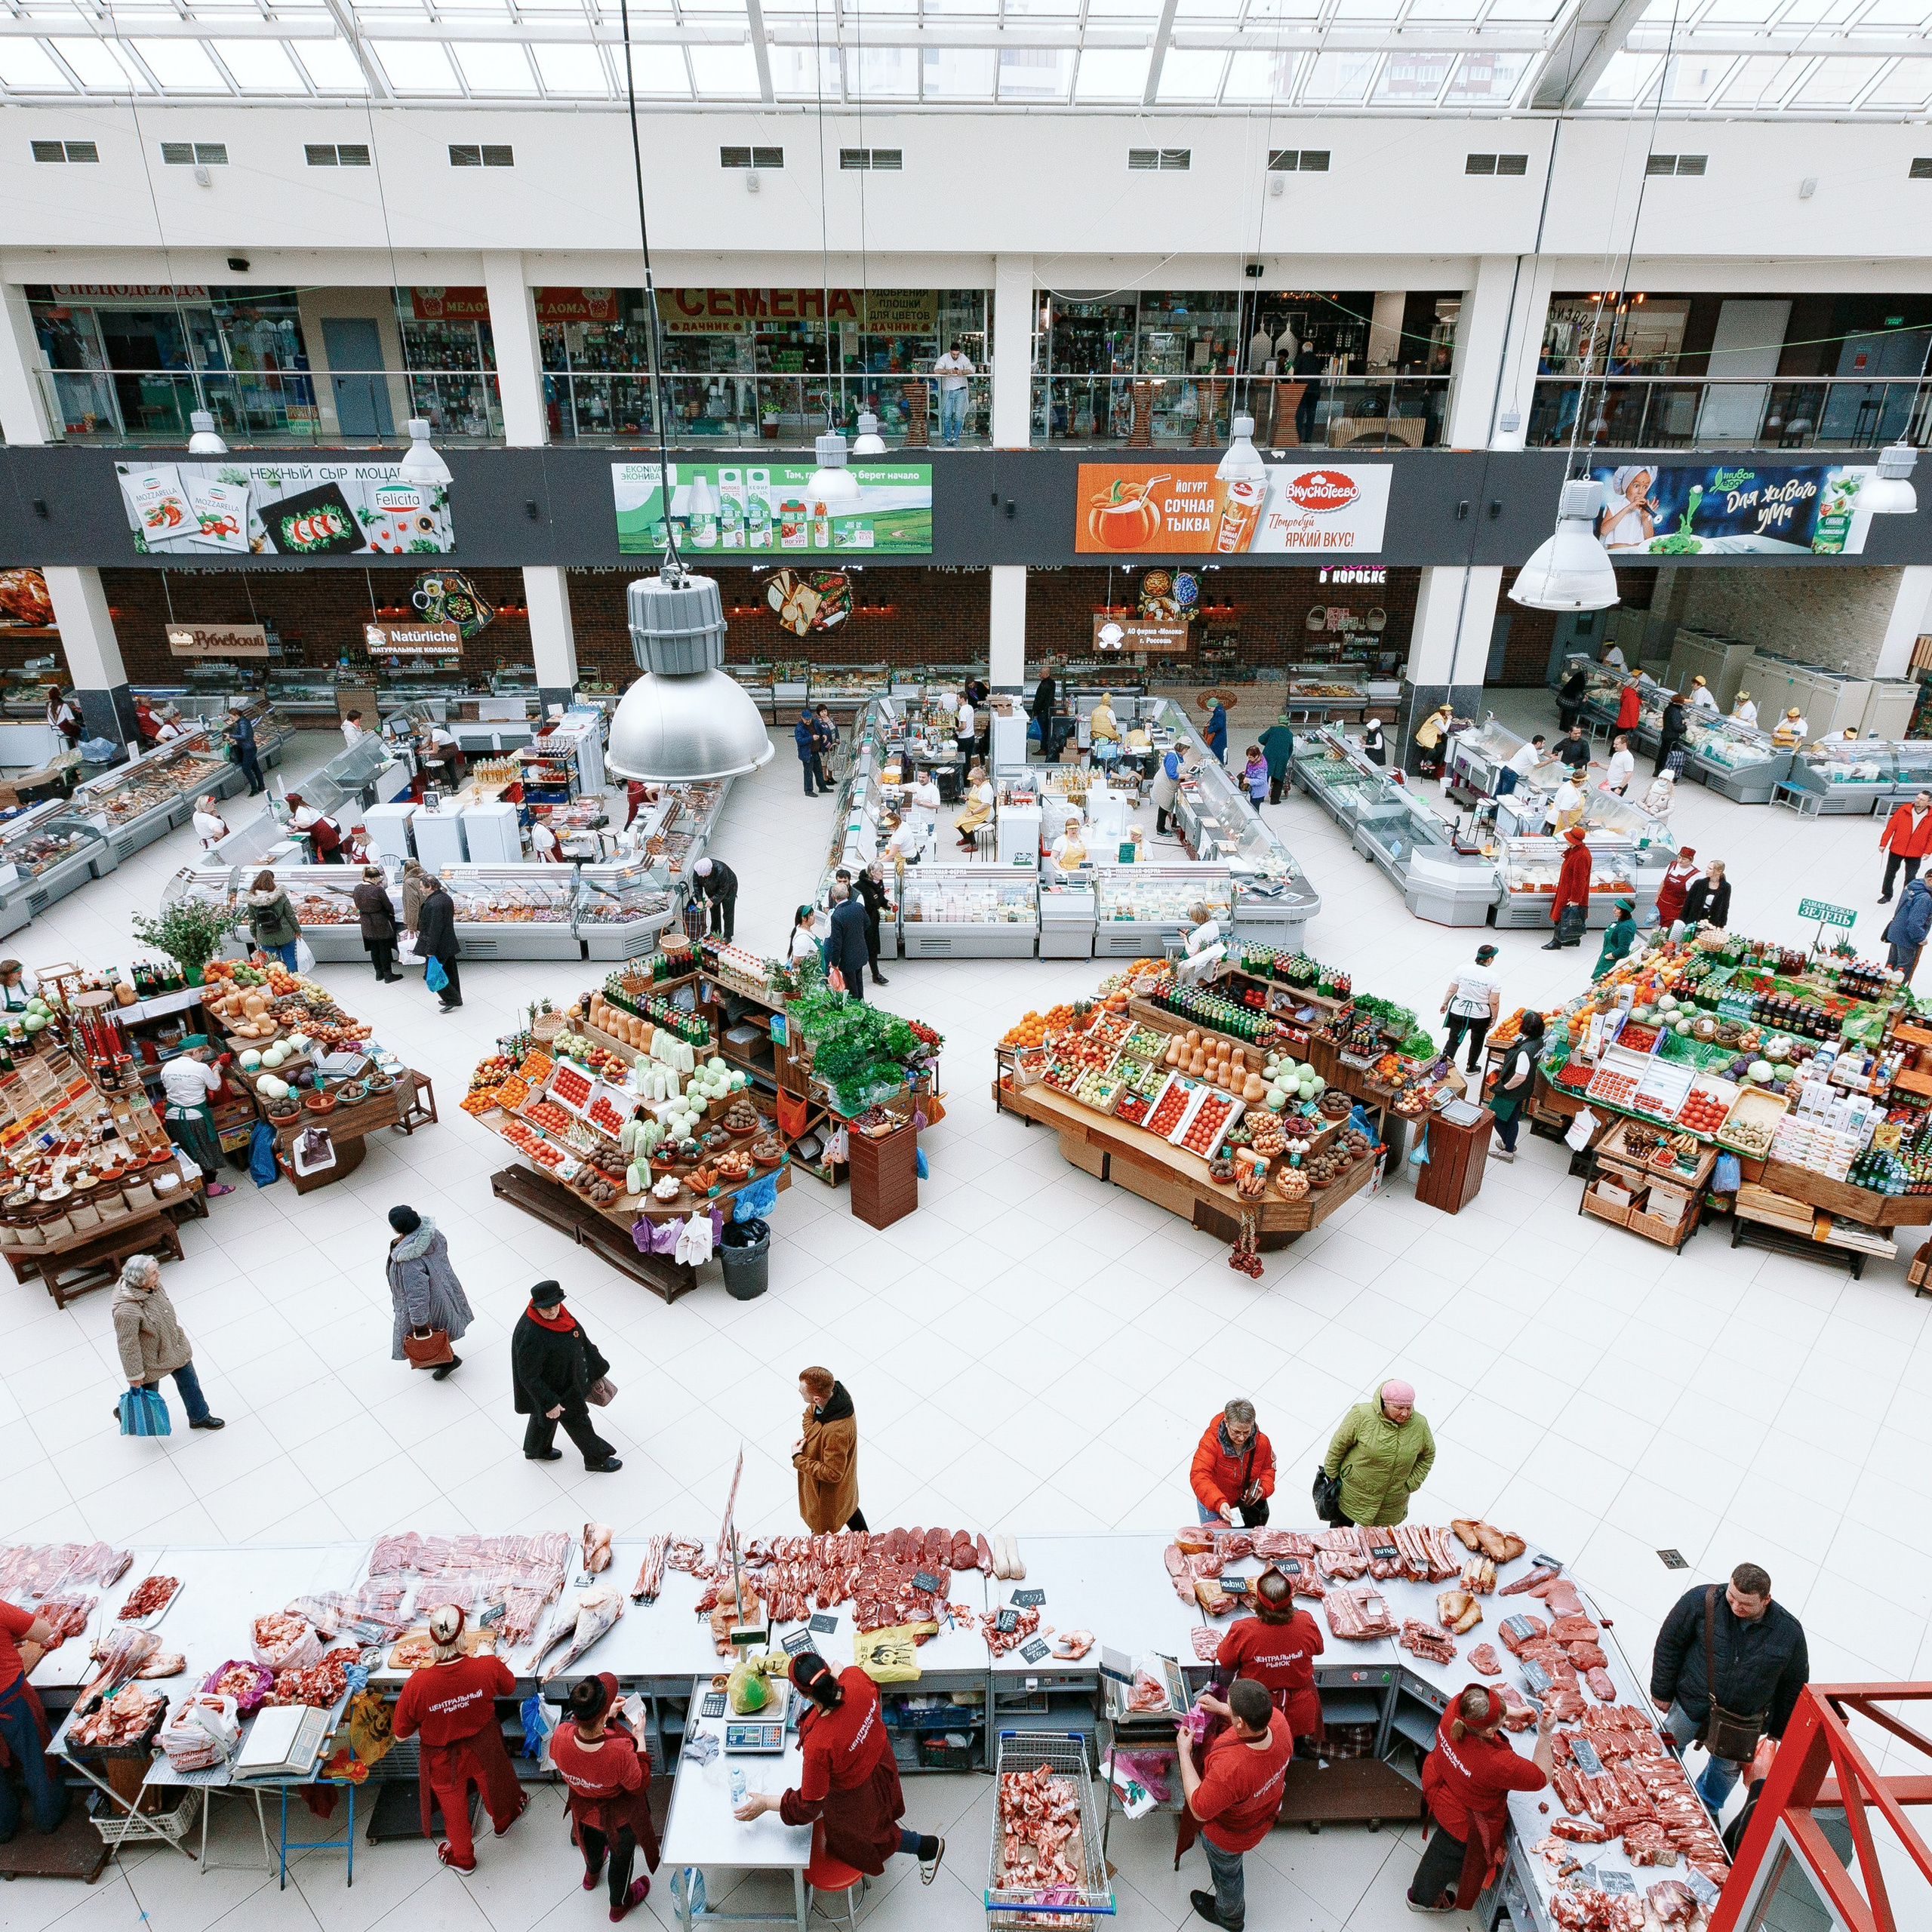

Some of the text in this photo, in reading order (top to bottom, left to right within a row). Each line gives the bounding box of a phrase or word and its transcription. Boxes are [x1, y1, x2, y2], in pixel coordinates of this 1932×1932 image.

[52, 284, 206, 298] СПЕЦОДЕЖДА
[871, 288, 929, 298] УДОБРЕНИЯ
[547, 303, 587, 314] ДОМА
[677, 288, 858, 317] СЕМЕНА
[878, 299, 921, 310] ПЛОШКИ
[869, 311, 931, 322] ДЛЯ ЦВЕТОВ
[681, 323, 730, 333] ДАЧНИК
[870, 323, 918, 334] ДАЧНИК
[249, 465, 313, 480] НЕЖНЫЙ
[319, 467, 348, 479] СЫР
[784, 469, 804, 480] Там,
[858, 469, 885, 481] берет
[1175, 479, 1208, 493] ЙОГУРТ
[136, 488, 177, 503] MOZZARELLA
[376, 493, 420, 506] Felicita
[195, 497, 240, 512] MOZZARELLA
[1164, 499, 1214, 513] СОЧНАЯ
[1167, 517, 1211, 532] ТЫКВА
[1269, 512, 1315, 530] Попробуй
[1285, 531, 1354, 547] ЯРКИЙ ВКУС!
[1319, 570, 1386, 583] В КОРОБКЕ
[391, 630, 457, 642] Natürliche
[1137, 628, 1158, 637] фирма
[1802, 899, 1855, 917] САМАЯ СВЕЖАЯ
[1800, 906, 1851, 925] ЗЕЛЕНЬ
[1254, 1649, 1303, 1663] ЦЕНТРАЛЬНЫЙ
[1266, 1660, 1291, 1669] РЫНОК
[429, 1688, 483, 1712] ЦЕНТРАЛЬНЫЙ
[443, 1700, 469, 1714] РЫНОК
[848, 1698, 877, 1752] ЦЕНТРАЛЬНЫЙ
[860, 1716, 874, 1744] РЫНОК
[1440, 1742, 1457, 1769] РЫНОК
